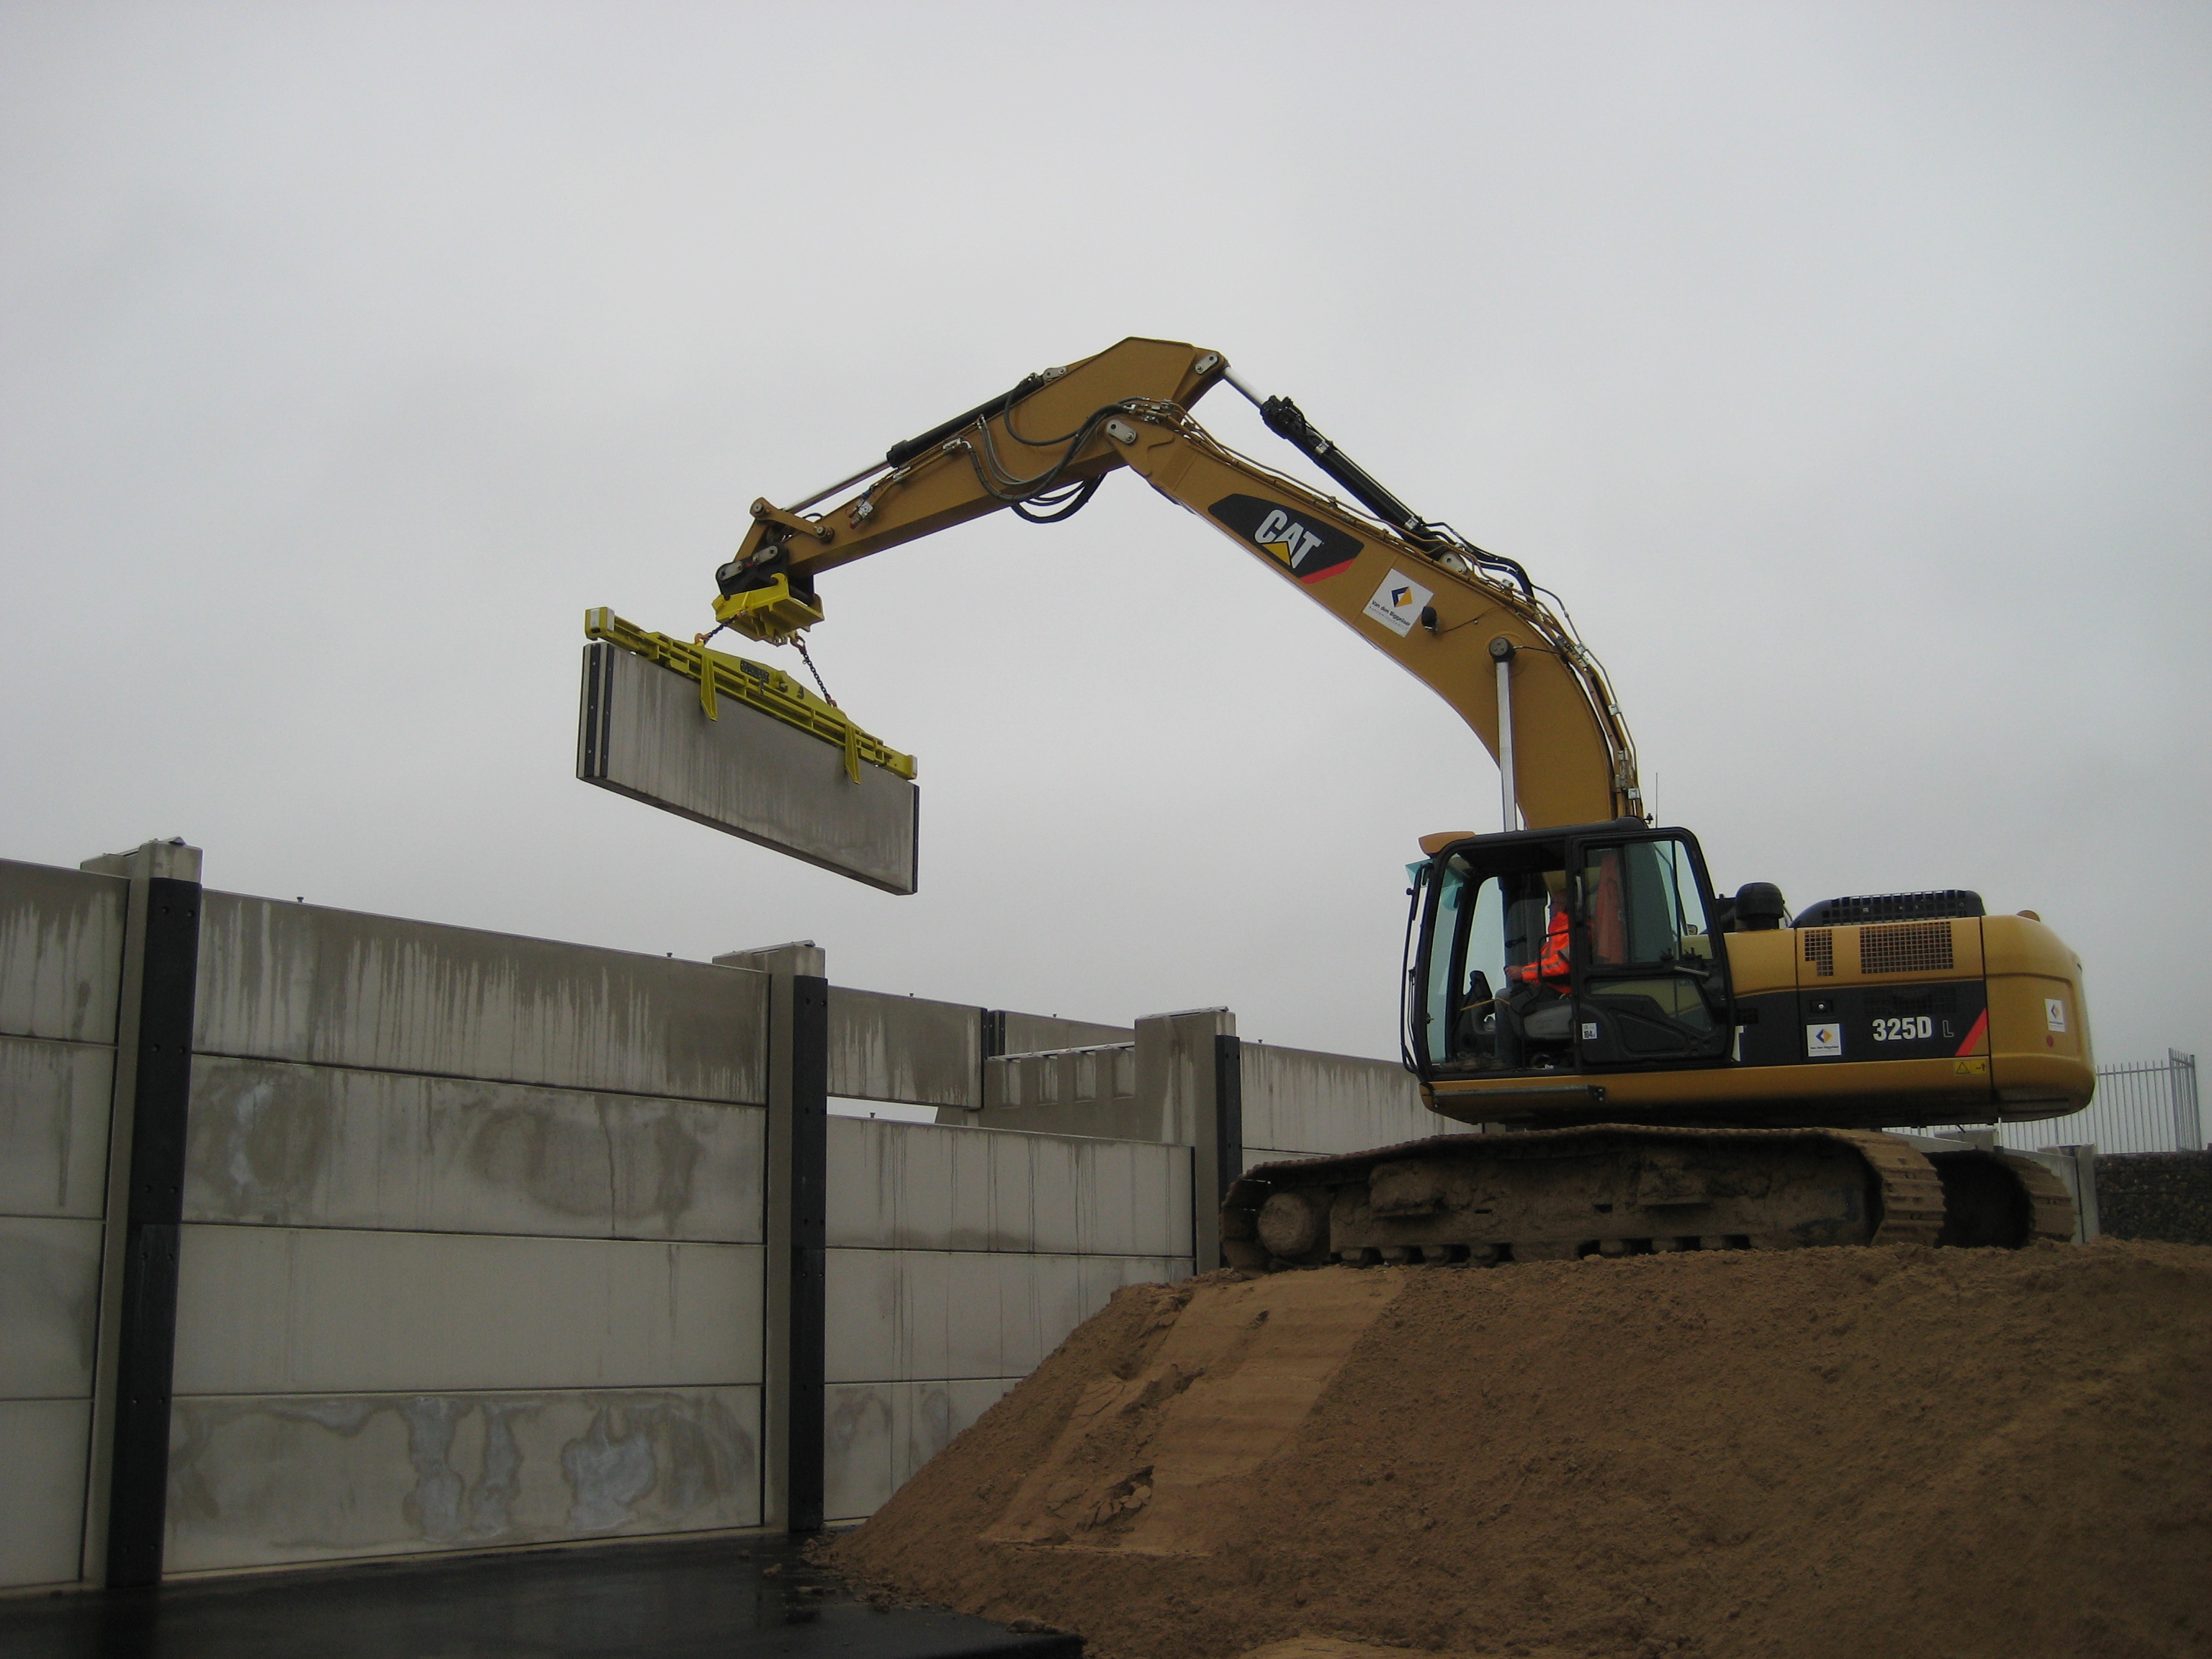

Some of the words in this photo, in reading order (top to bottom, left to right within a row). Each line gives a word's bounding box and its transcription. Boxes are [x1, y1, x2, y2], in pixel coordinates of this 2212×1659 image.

[1254, 509, 1323, 569] CAT
[1372, 600, 1380, 608] Van
[1872, 1016, 1932, 1041] 325D
[1942, 1020, 1954, 1038] L
